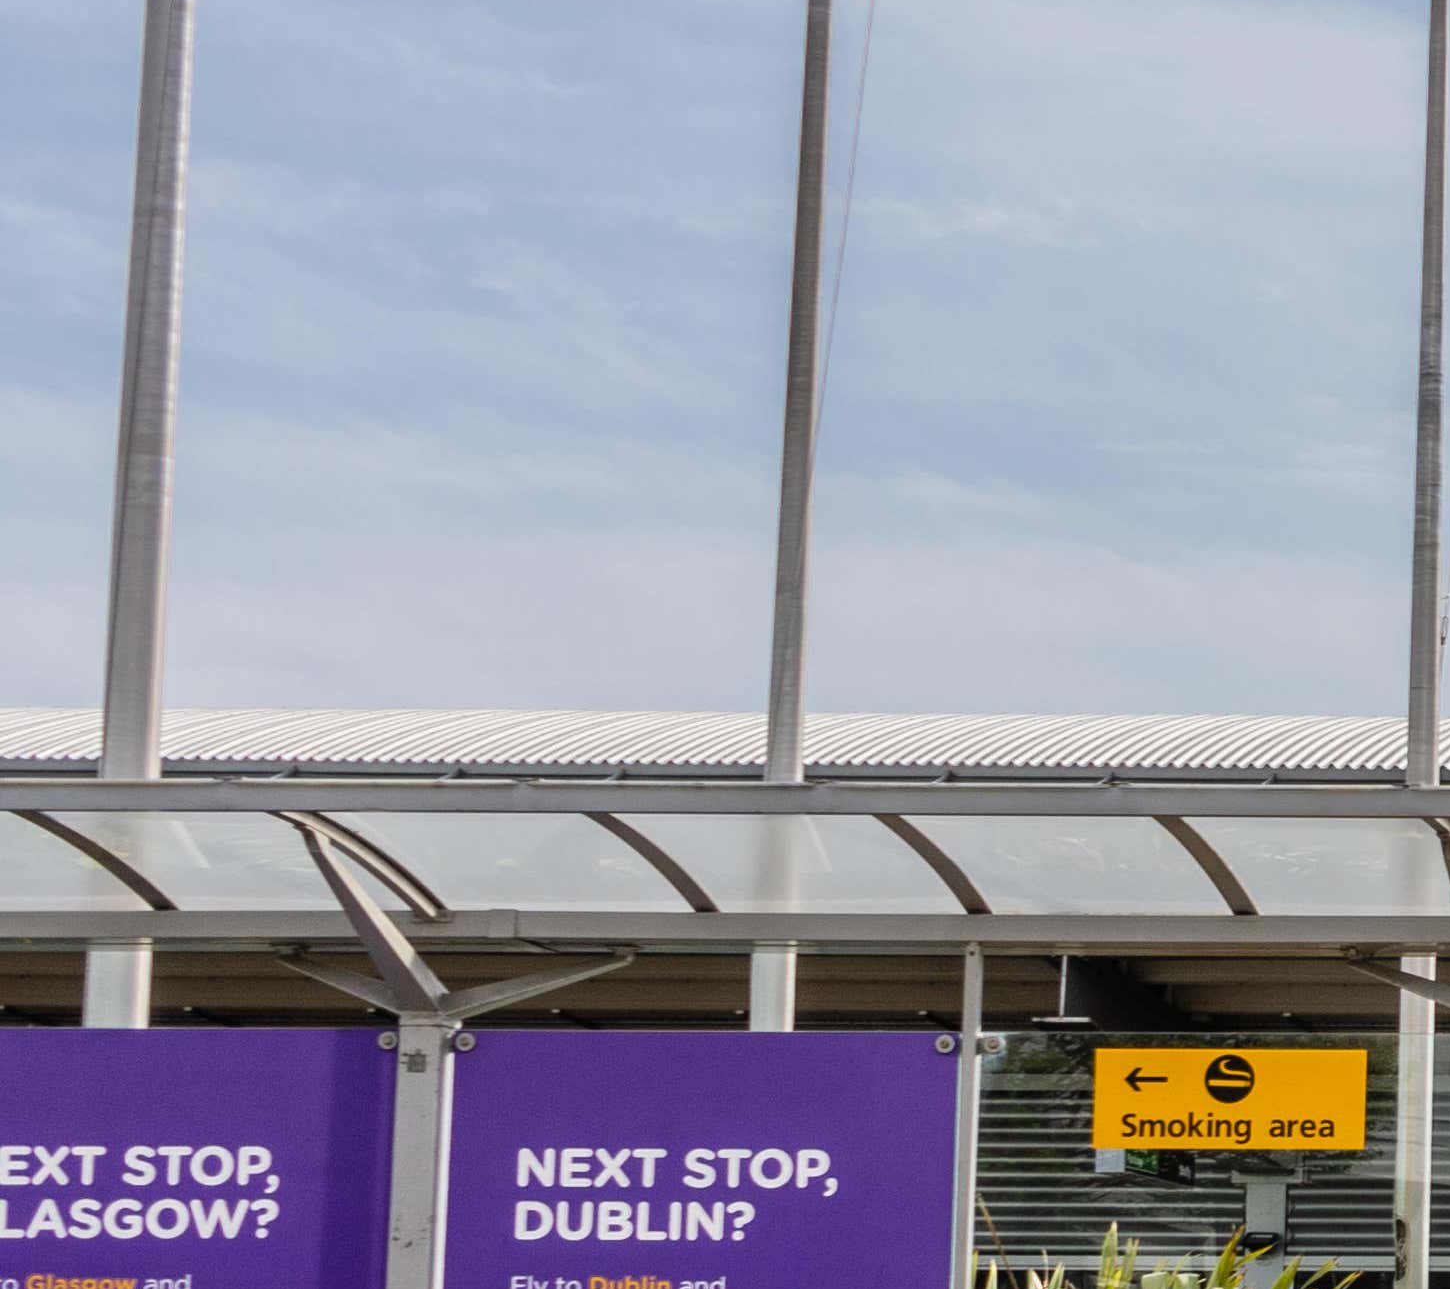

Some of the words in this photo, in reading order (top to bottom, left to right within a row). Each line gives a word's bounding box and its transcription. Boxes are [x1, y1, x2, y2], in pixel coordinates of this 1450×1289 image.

[1121, 1112, 1252, 1144] Smoking
[1269, 1119, 1335, 1138] area
[0, 1146, 107, 1186] EXT
[122, 1145, 280, 1194] STOP,
[517, 1148, 667, 1188] NEXT
[683, 1148, 838, 1197] STOP,
[0, 1198, 280, 1239] LASGOW?
[514, 1201, 755, 1241] DUBLIN?
